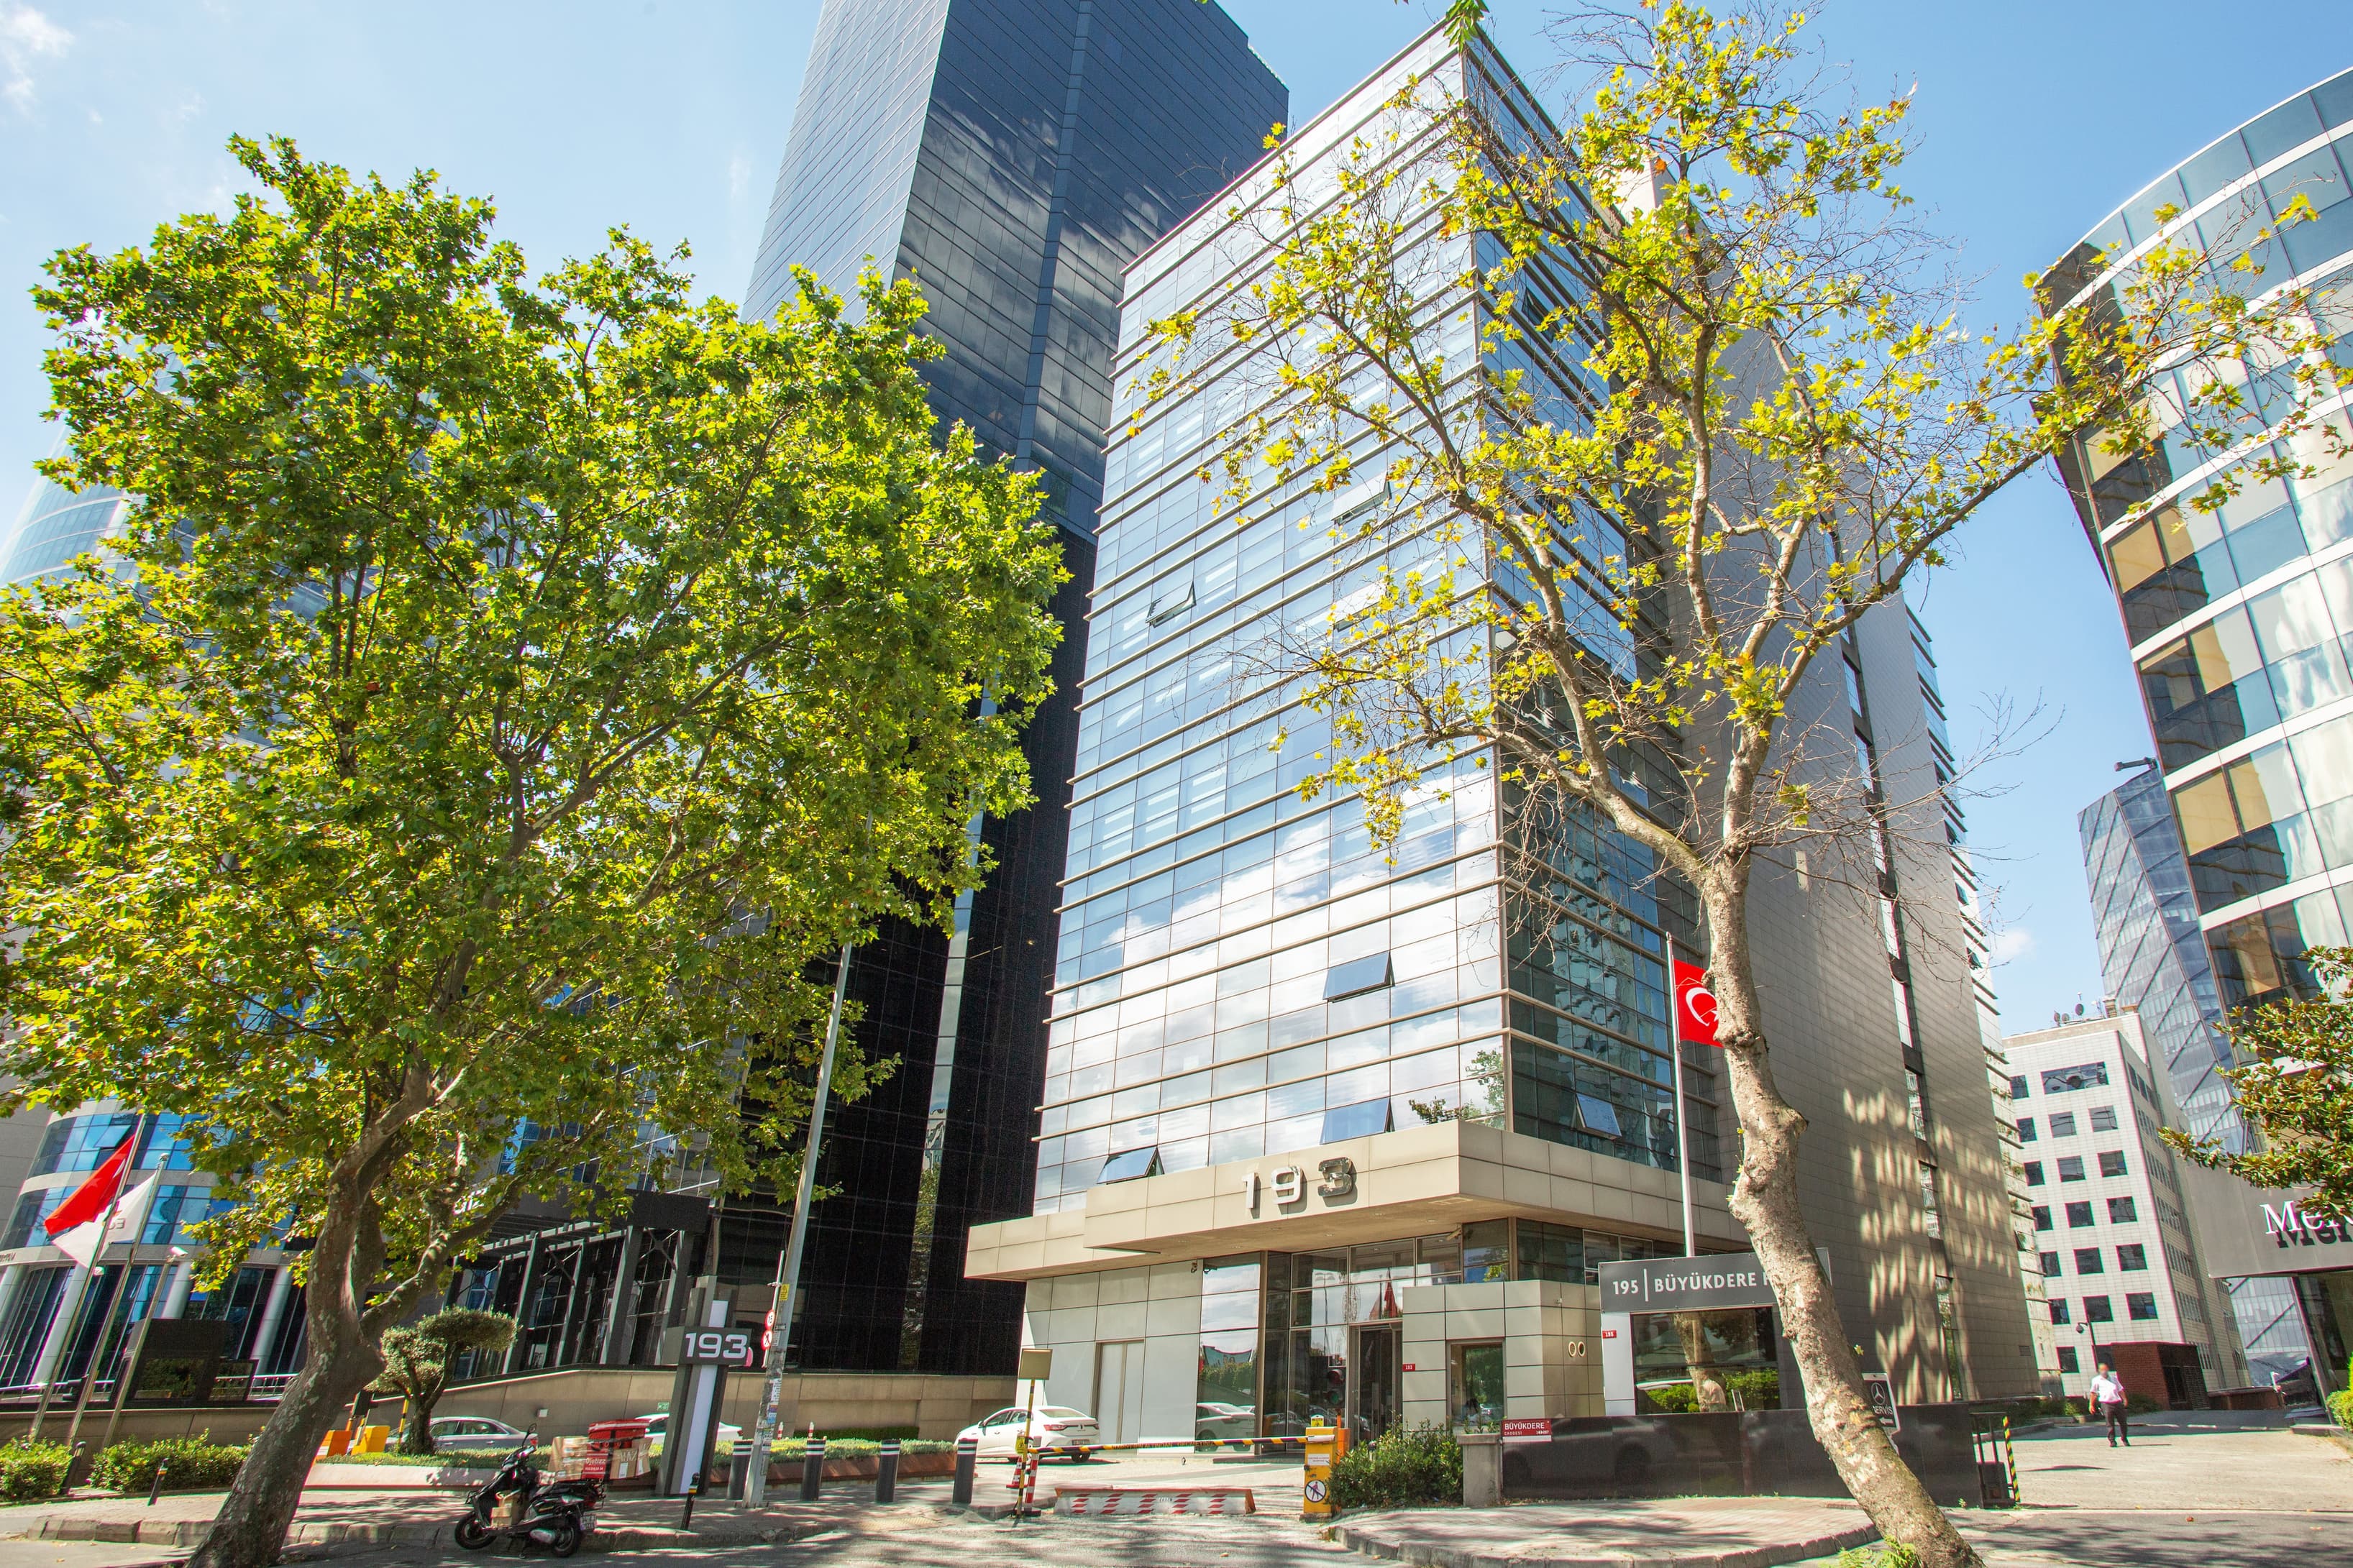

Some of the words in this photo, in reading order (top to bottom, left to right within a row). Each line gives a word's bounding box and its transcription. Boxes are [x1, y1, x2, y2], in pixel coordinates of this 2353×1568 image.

[1242, 1157, 1353, 1209] 193
[2260, 1200, 2353, 1234] Me
[1612, 1280, 1639, 1295] 195
[1655, 1272, 1757, 1293] BÜYÜKDERE
[685, 1332, 748, 1358] 193
